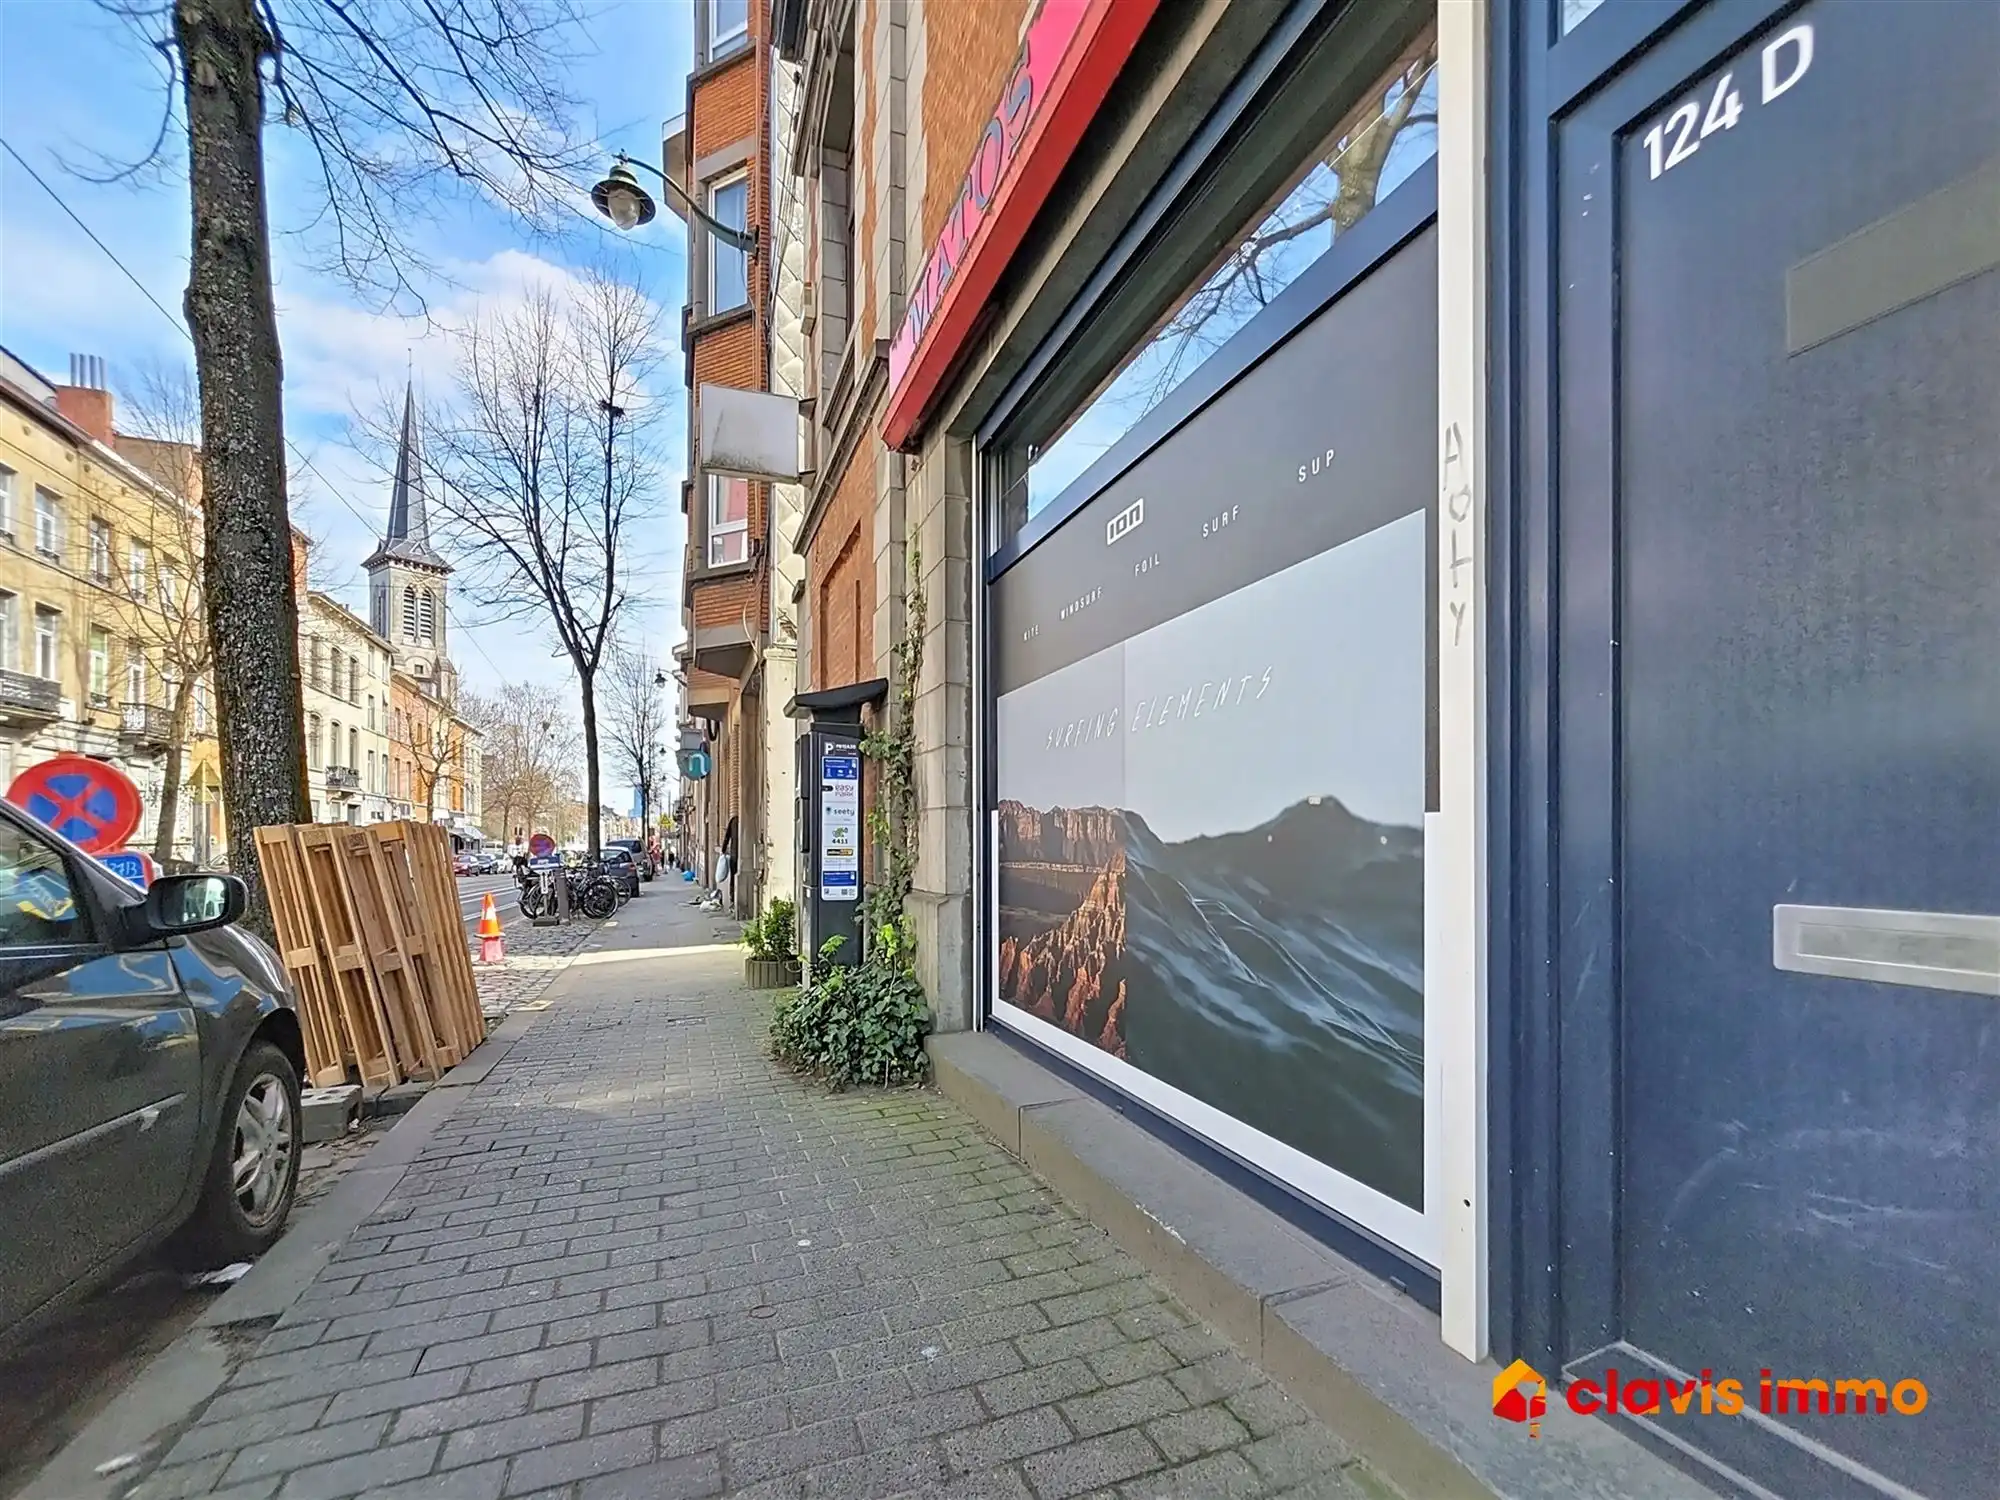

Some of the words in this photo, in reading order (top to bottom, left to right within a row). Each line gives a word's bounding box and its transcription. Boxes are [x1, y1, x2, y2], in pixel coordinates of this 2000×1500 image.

[1643, 71, 1743, 181] 124
[1762, 24, 1814, 105] D
[1023, 624, 1040, 641] KITE
[1060, 586, 1102, 620] WINDSURF
[1134, 553, 1160, 577] FOIL
[1202, 504, 1240, 538] SURF
[1298, 448, 1334, 482] SUP
[1046, 706, 1119, 750] SURFING
[1131, 665, 1272, 733] ELEMENTS
[833, 808, 855, 816] seety
